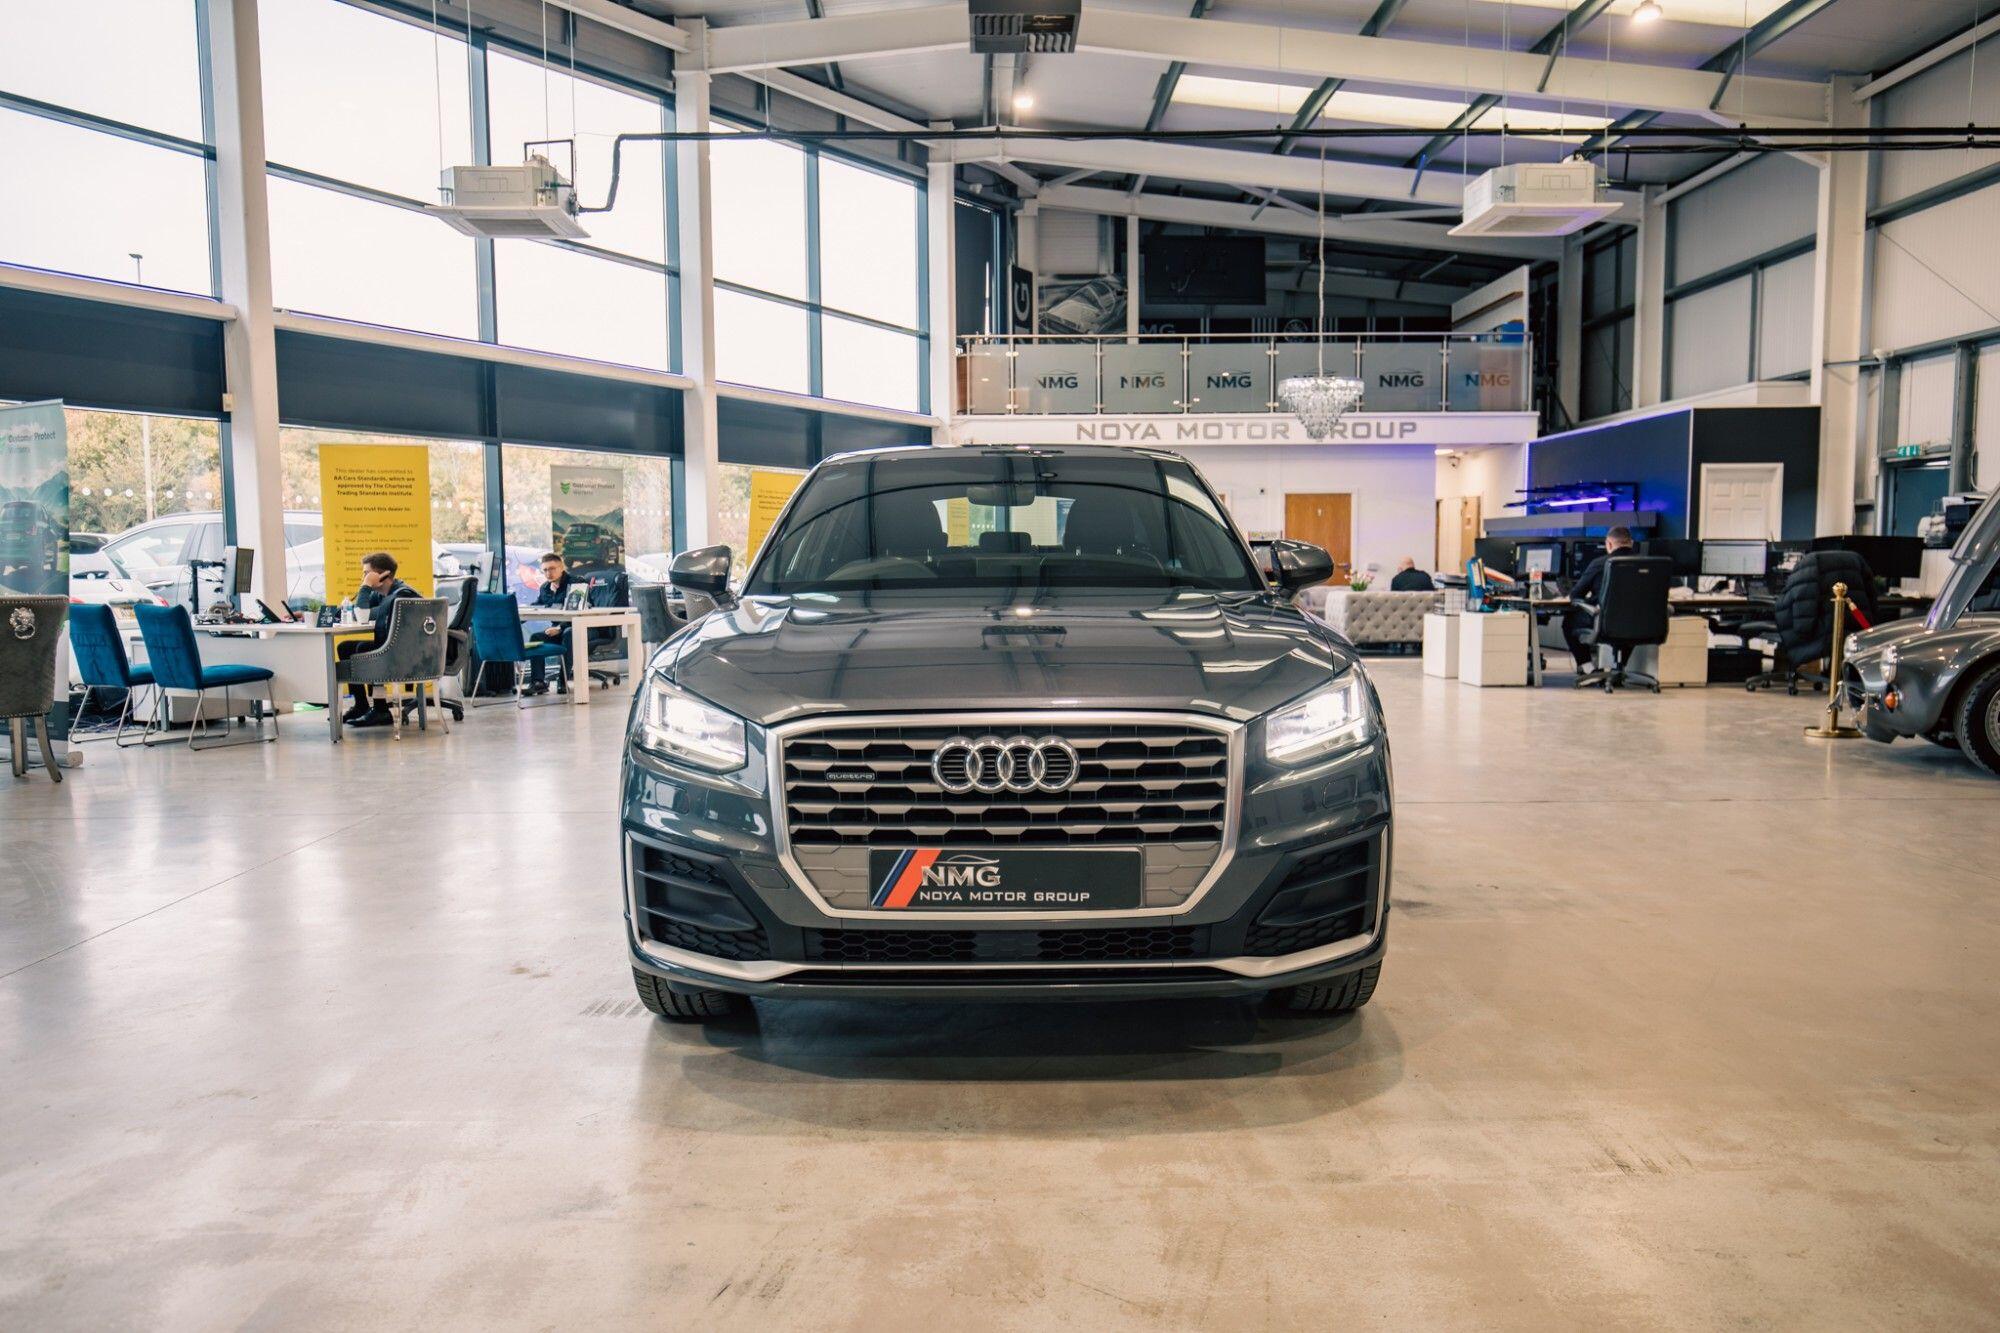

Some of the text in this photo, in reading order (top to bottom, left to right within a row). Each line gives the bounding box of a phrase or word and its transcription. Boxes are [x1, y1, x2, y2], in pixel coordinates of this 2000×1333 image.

[1035, 376, 1078, 389] NMG
[1207, 376, 1252, 388] NMG
[1380, 375, 1424, 387] NMG
[1465, 373, 1511, 387] NMG
[34, 431, 56, 441] Protect
[1077, 421, 1417, 440] NOYA MOTOR ROUP
[921, 865, 1001, 887] NMG
[920, 891, 1090, 902] NOYA MOTOR GROUP
